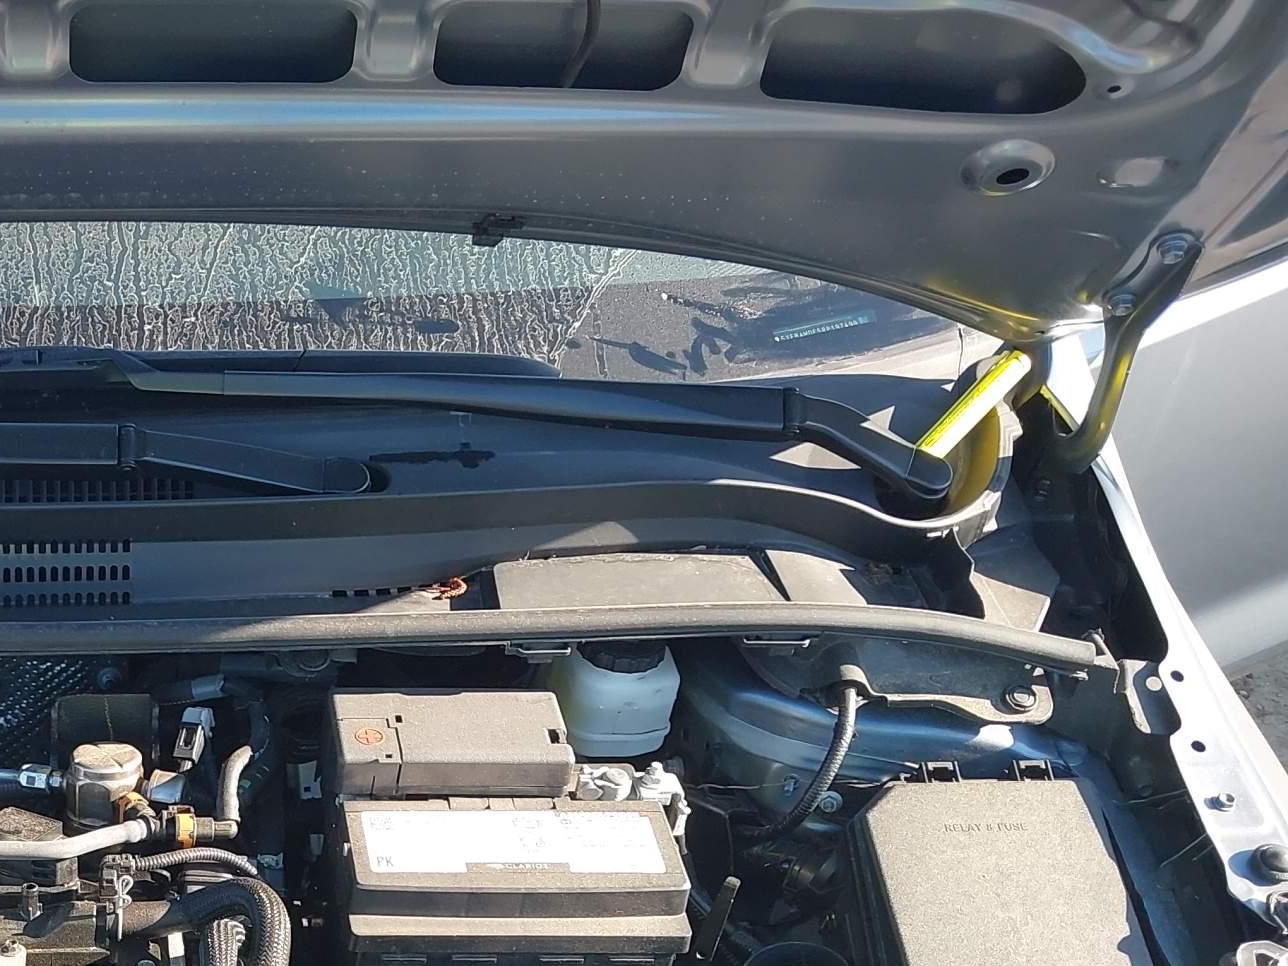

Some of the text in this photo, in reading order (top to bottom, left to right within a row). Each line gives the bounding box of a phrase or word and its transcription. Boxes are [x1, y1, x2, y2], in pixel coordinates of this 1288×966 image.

[944, 823, 981, 833] RELAY
[996, 823, 1028, 832] FUSE
[376, 856, 394, 867] PK
